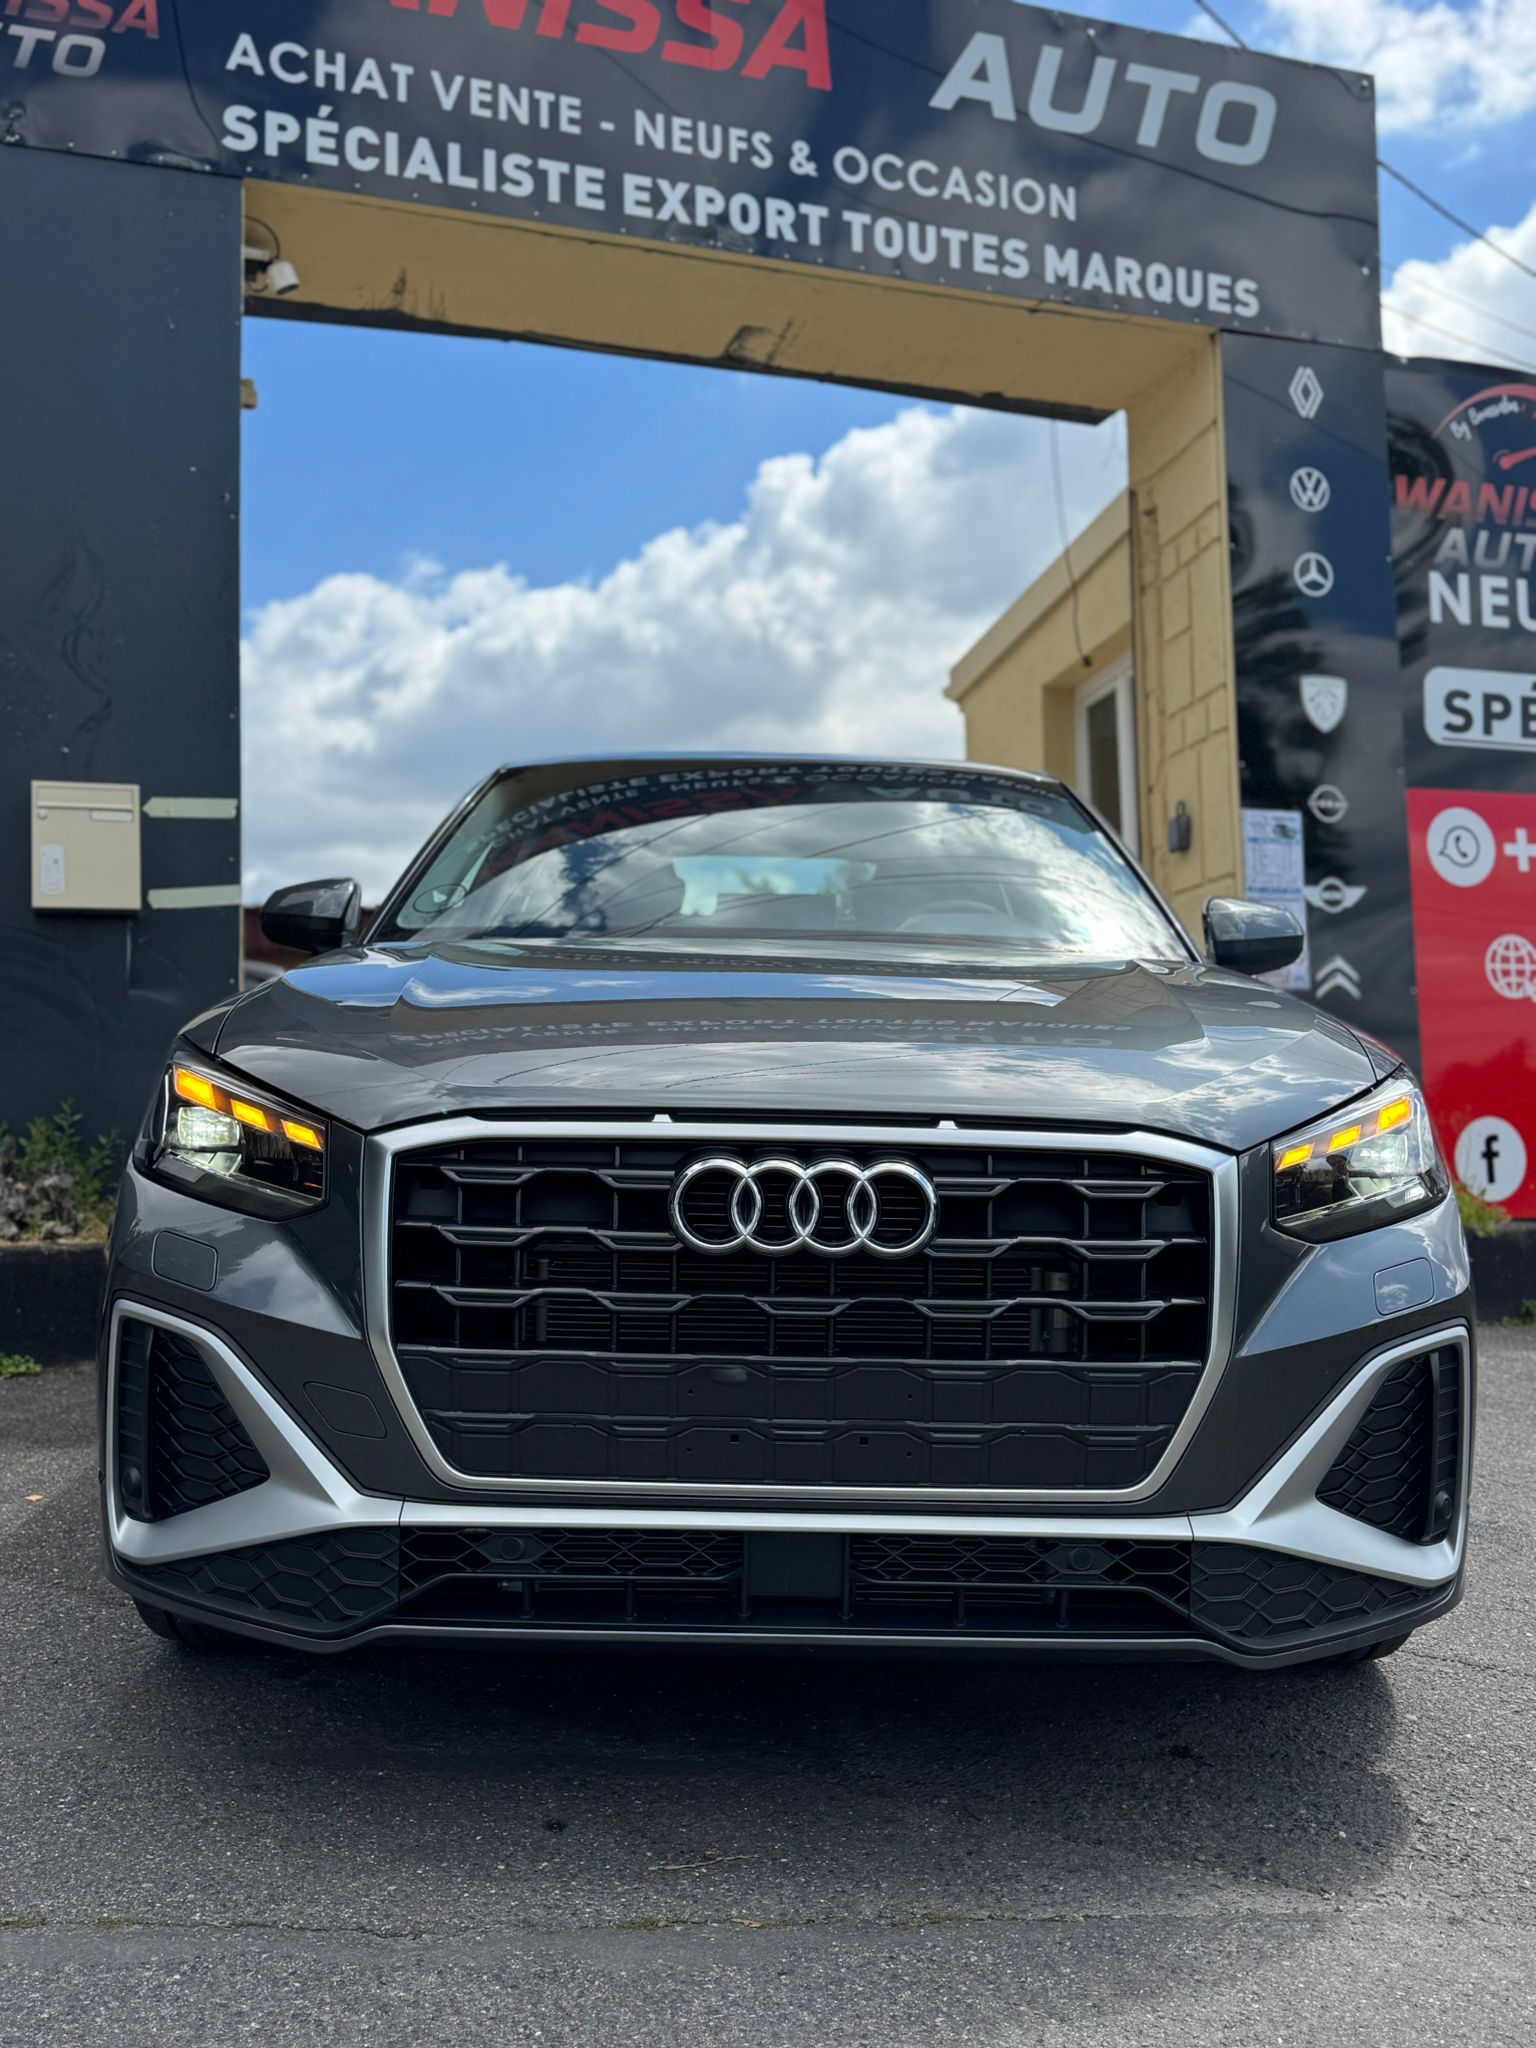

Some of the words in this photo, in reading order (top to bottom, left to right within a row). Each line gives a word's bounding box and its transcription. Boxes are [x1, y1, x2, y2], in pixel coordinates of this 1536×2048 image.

[0, 22, 107, 78] TO
[929, 31, 1278, 166] AUTO
[225, 33, 414, 104] ACHAT
[430, 69, 582, 135] VENTE
[599, 121, 615, 132] -
[634, 109, 773, 169] NEUFS
[789, 141, 818, 177] &
[833, 146, 1077, 221] OCCASION
[221, 105, 606, 211] SPÉCIALISTE
[623, 172, 829, 246] EXPORT
[842, 210, 1030, 279] TOUTES
[1043, 243, 1260, 318] MARQUES
[1395, 475, 1536, 526] WANI
